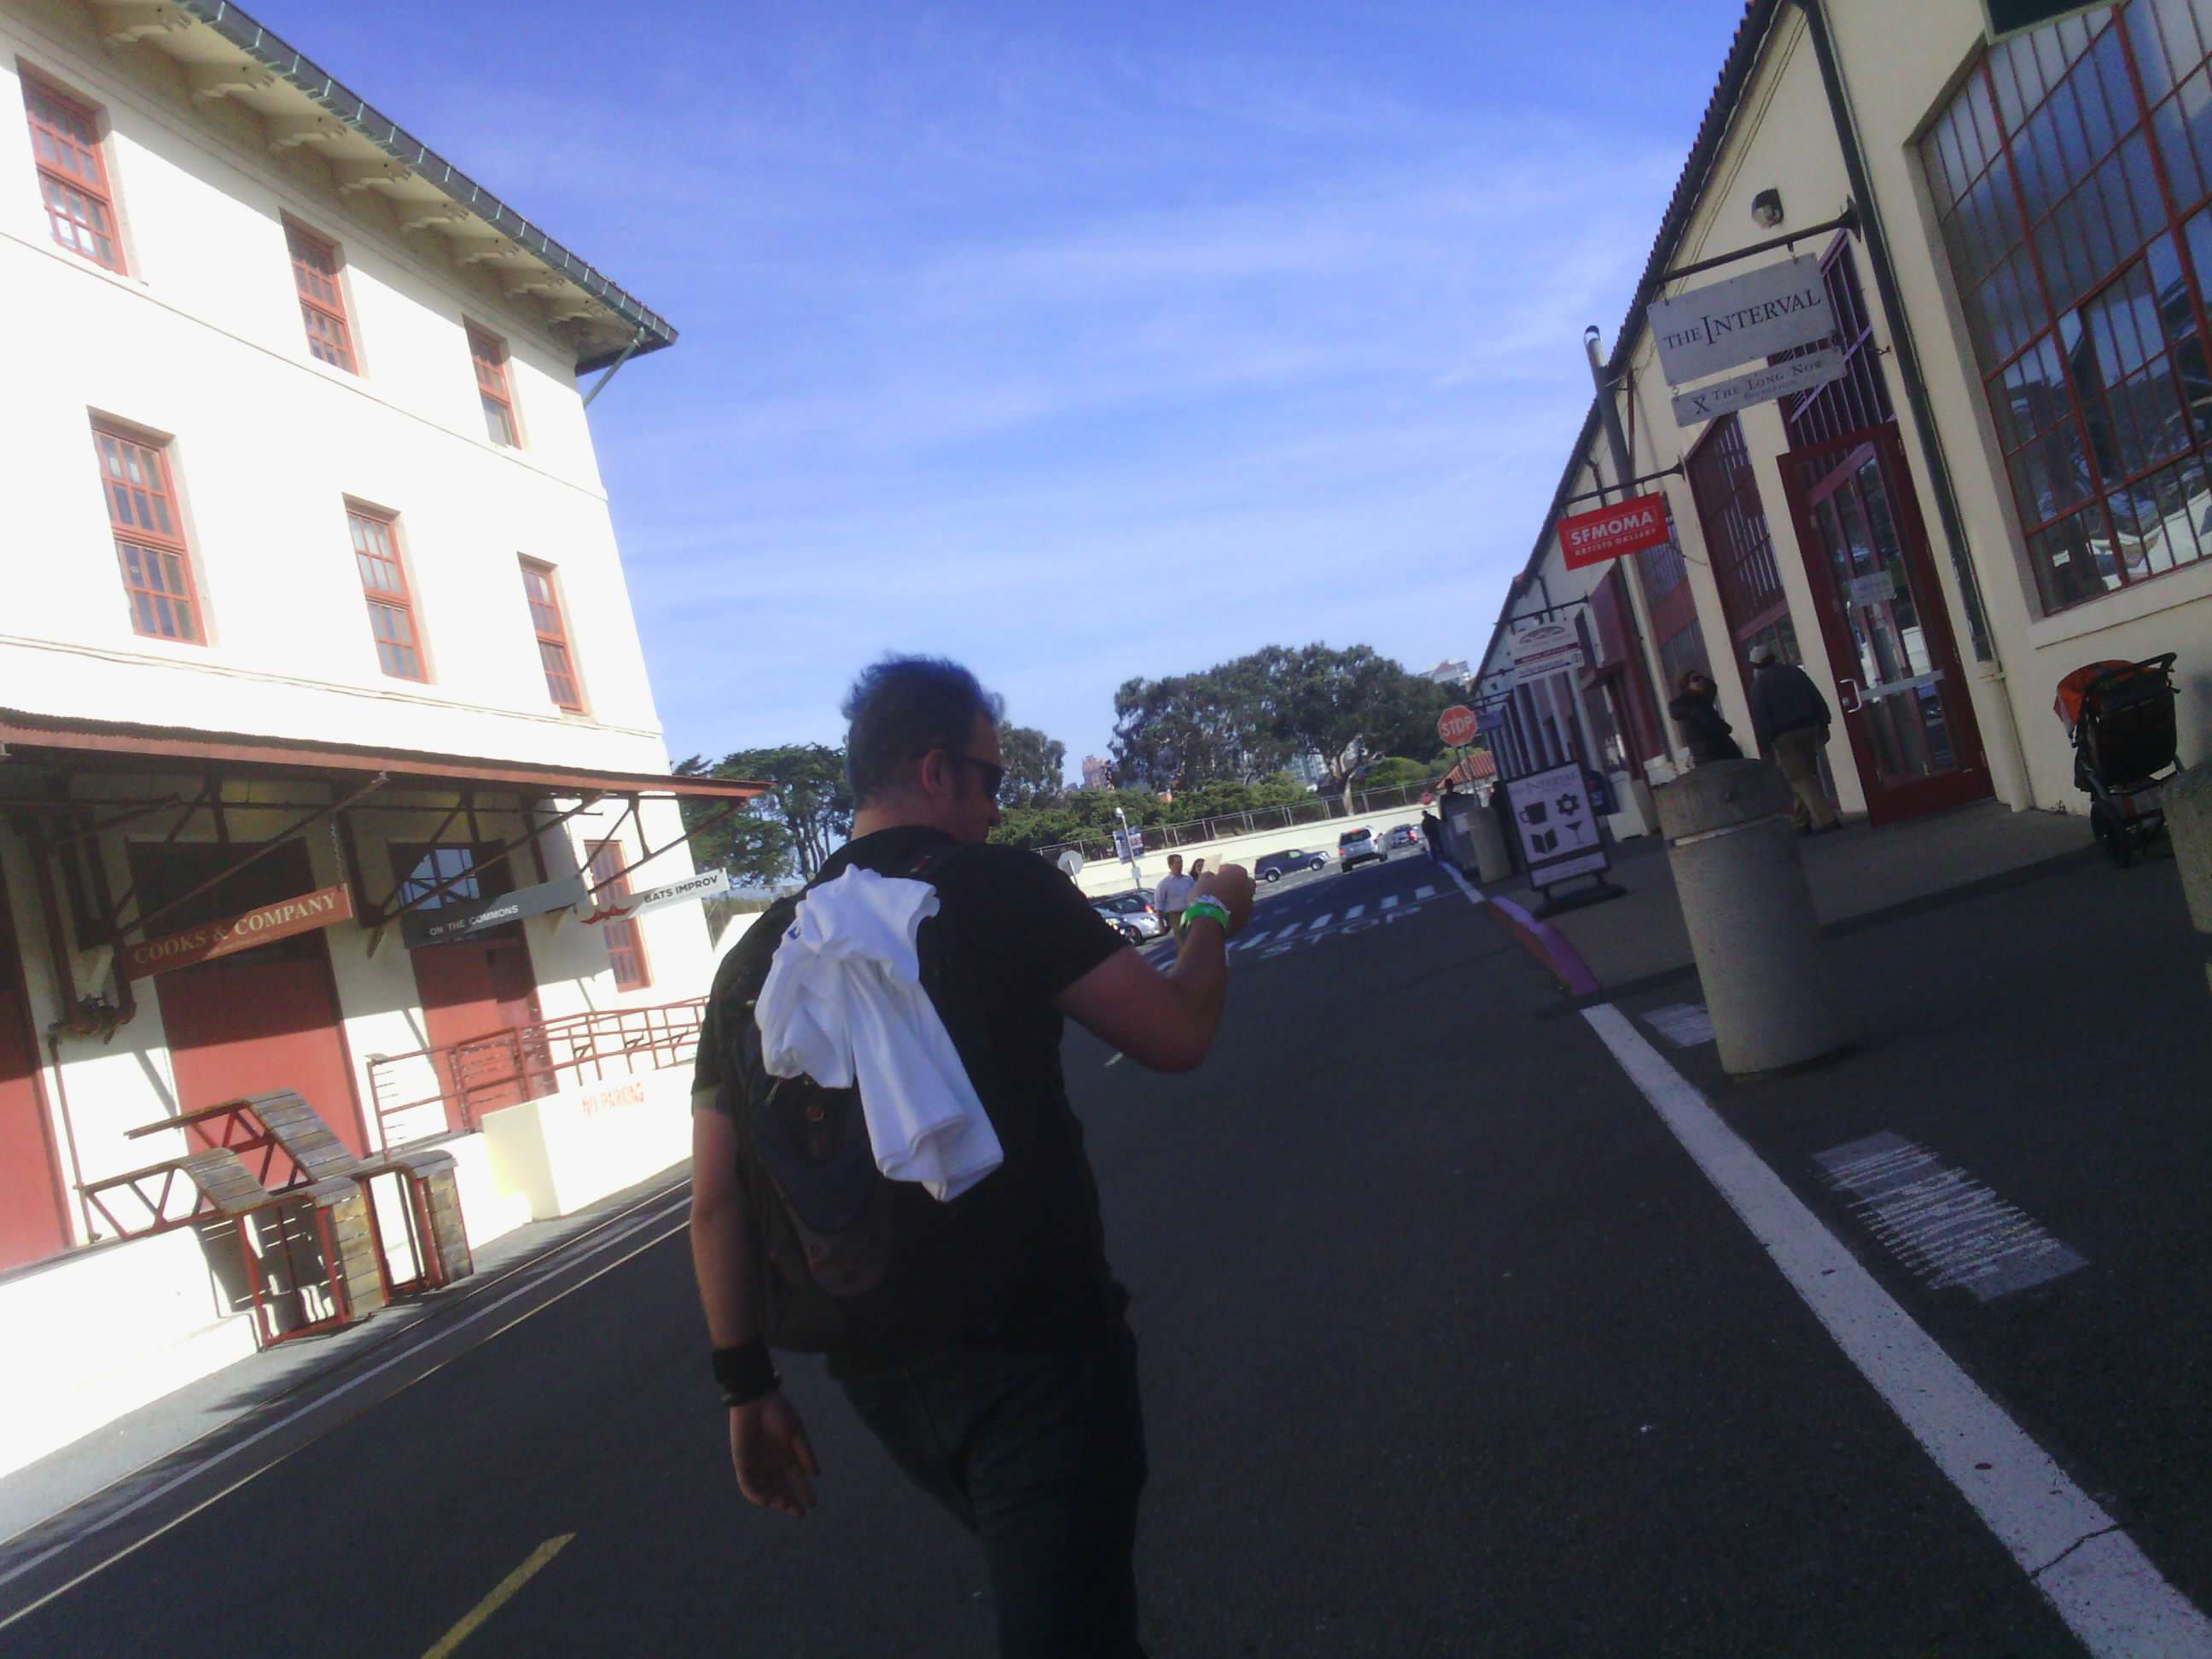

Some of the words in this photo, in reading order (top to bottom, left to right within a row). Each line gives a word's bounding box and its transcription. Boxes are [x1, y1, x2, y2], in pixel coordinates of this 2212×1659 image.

[1663, 326, 1703, 349] THE
[1700, 288, 1821, 346] INTERVAL
[1571, 511, 1654, 546] SFMOMA
[1440, 717, 1474, 736] STOP
[675, 875, 719, 894] IMPROV
[134, 930, 207, 963] COOKS
[209, 925, 229, 940] &
[234, 892, 337, 935] COMPANY
[448, 919, 465, 929] THE
[469, 905, 519, 925] COMMONS
